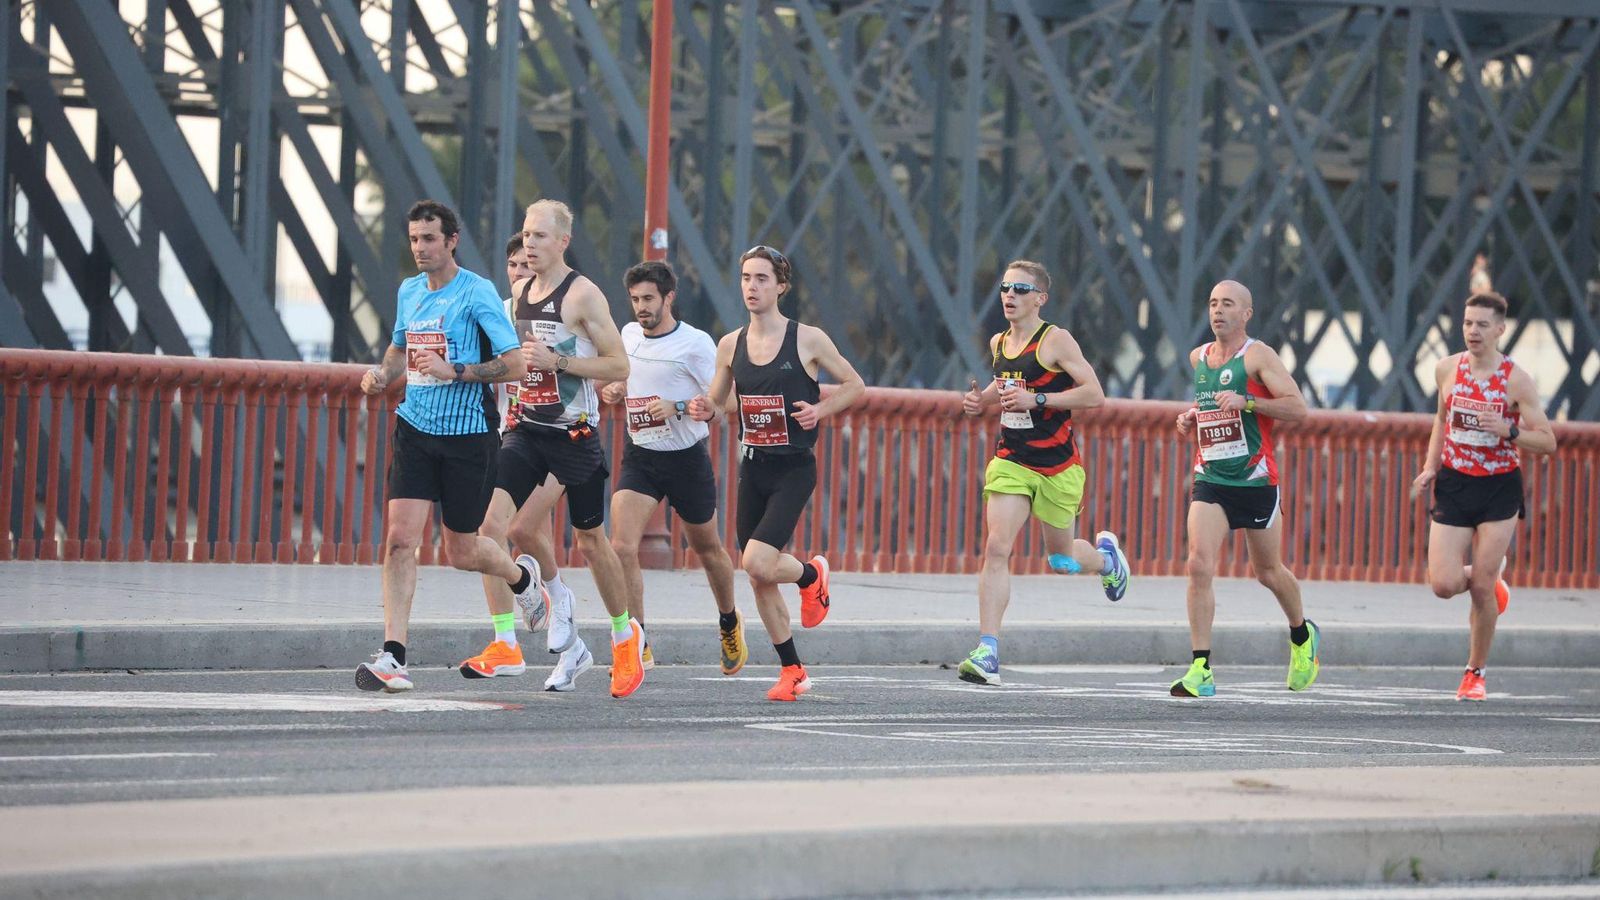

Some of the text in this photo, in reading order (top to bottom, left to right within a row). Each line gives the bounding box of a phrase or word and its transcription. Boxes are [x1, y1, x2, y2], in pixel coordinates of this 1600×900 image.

[524, 371, 543, 382] 350
[747, 398, 780, 406] GENERALI
[749, 414, 772, 424] 5289
[1204, 410, 1236, 421] GENERALI
[1461, 414, 1478, 426] 156
[1204, 426, 1233, 438] 11810
